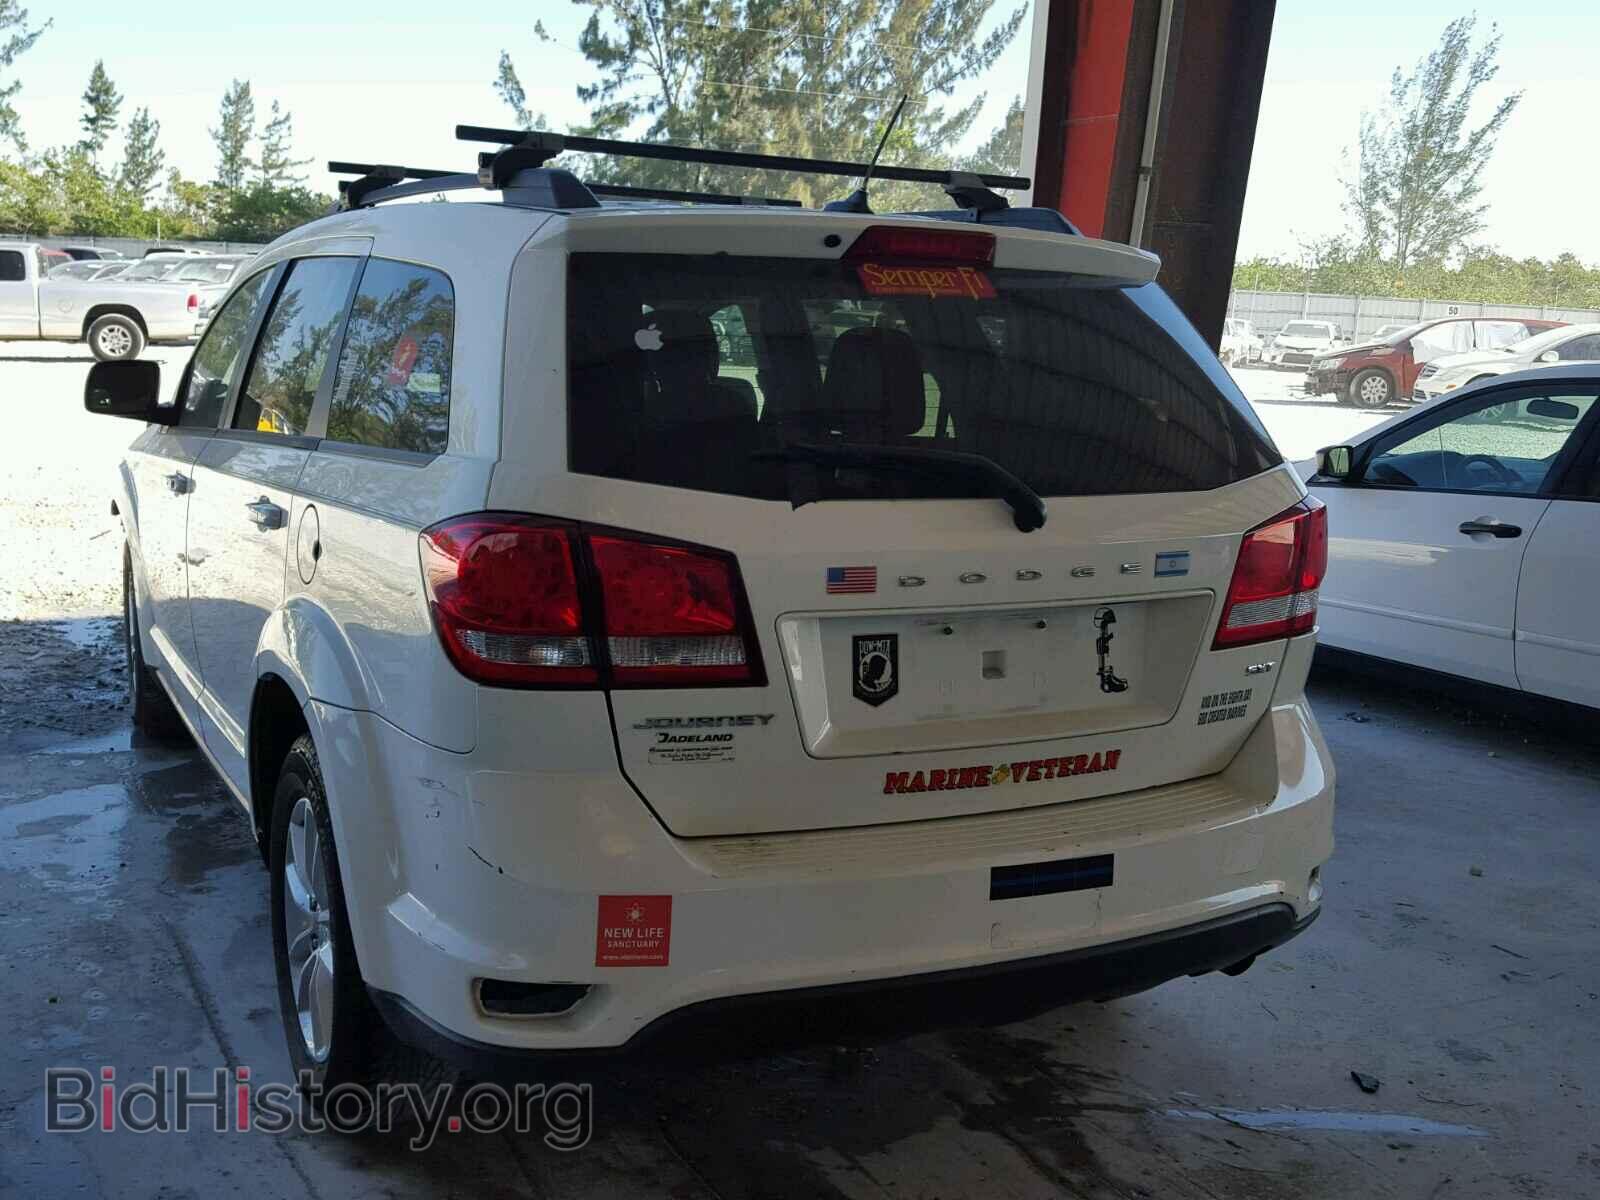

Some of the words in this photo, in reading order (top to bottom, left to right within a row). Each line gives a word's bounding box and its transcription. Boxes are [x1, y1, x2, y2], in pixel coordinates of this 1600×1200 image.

[864, 264, 957, 298] Semper
[957, 267, 984, 301] Fi
[1449, 306, 1458, 315] 50
[898, 562, 1143, 587] DODGE
[632, 714, 775, 730] JOURNEY
[884, 765, 993, 794] MARINE
[1010, 750, 1122, 783] VETERAN
[604, 928, 633, 938] NEW
[637, 928, 664, 938] LIFE
[608, 940, 660, 948] SANCTUARY
